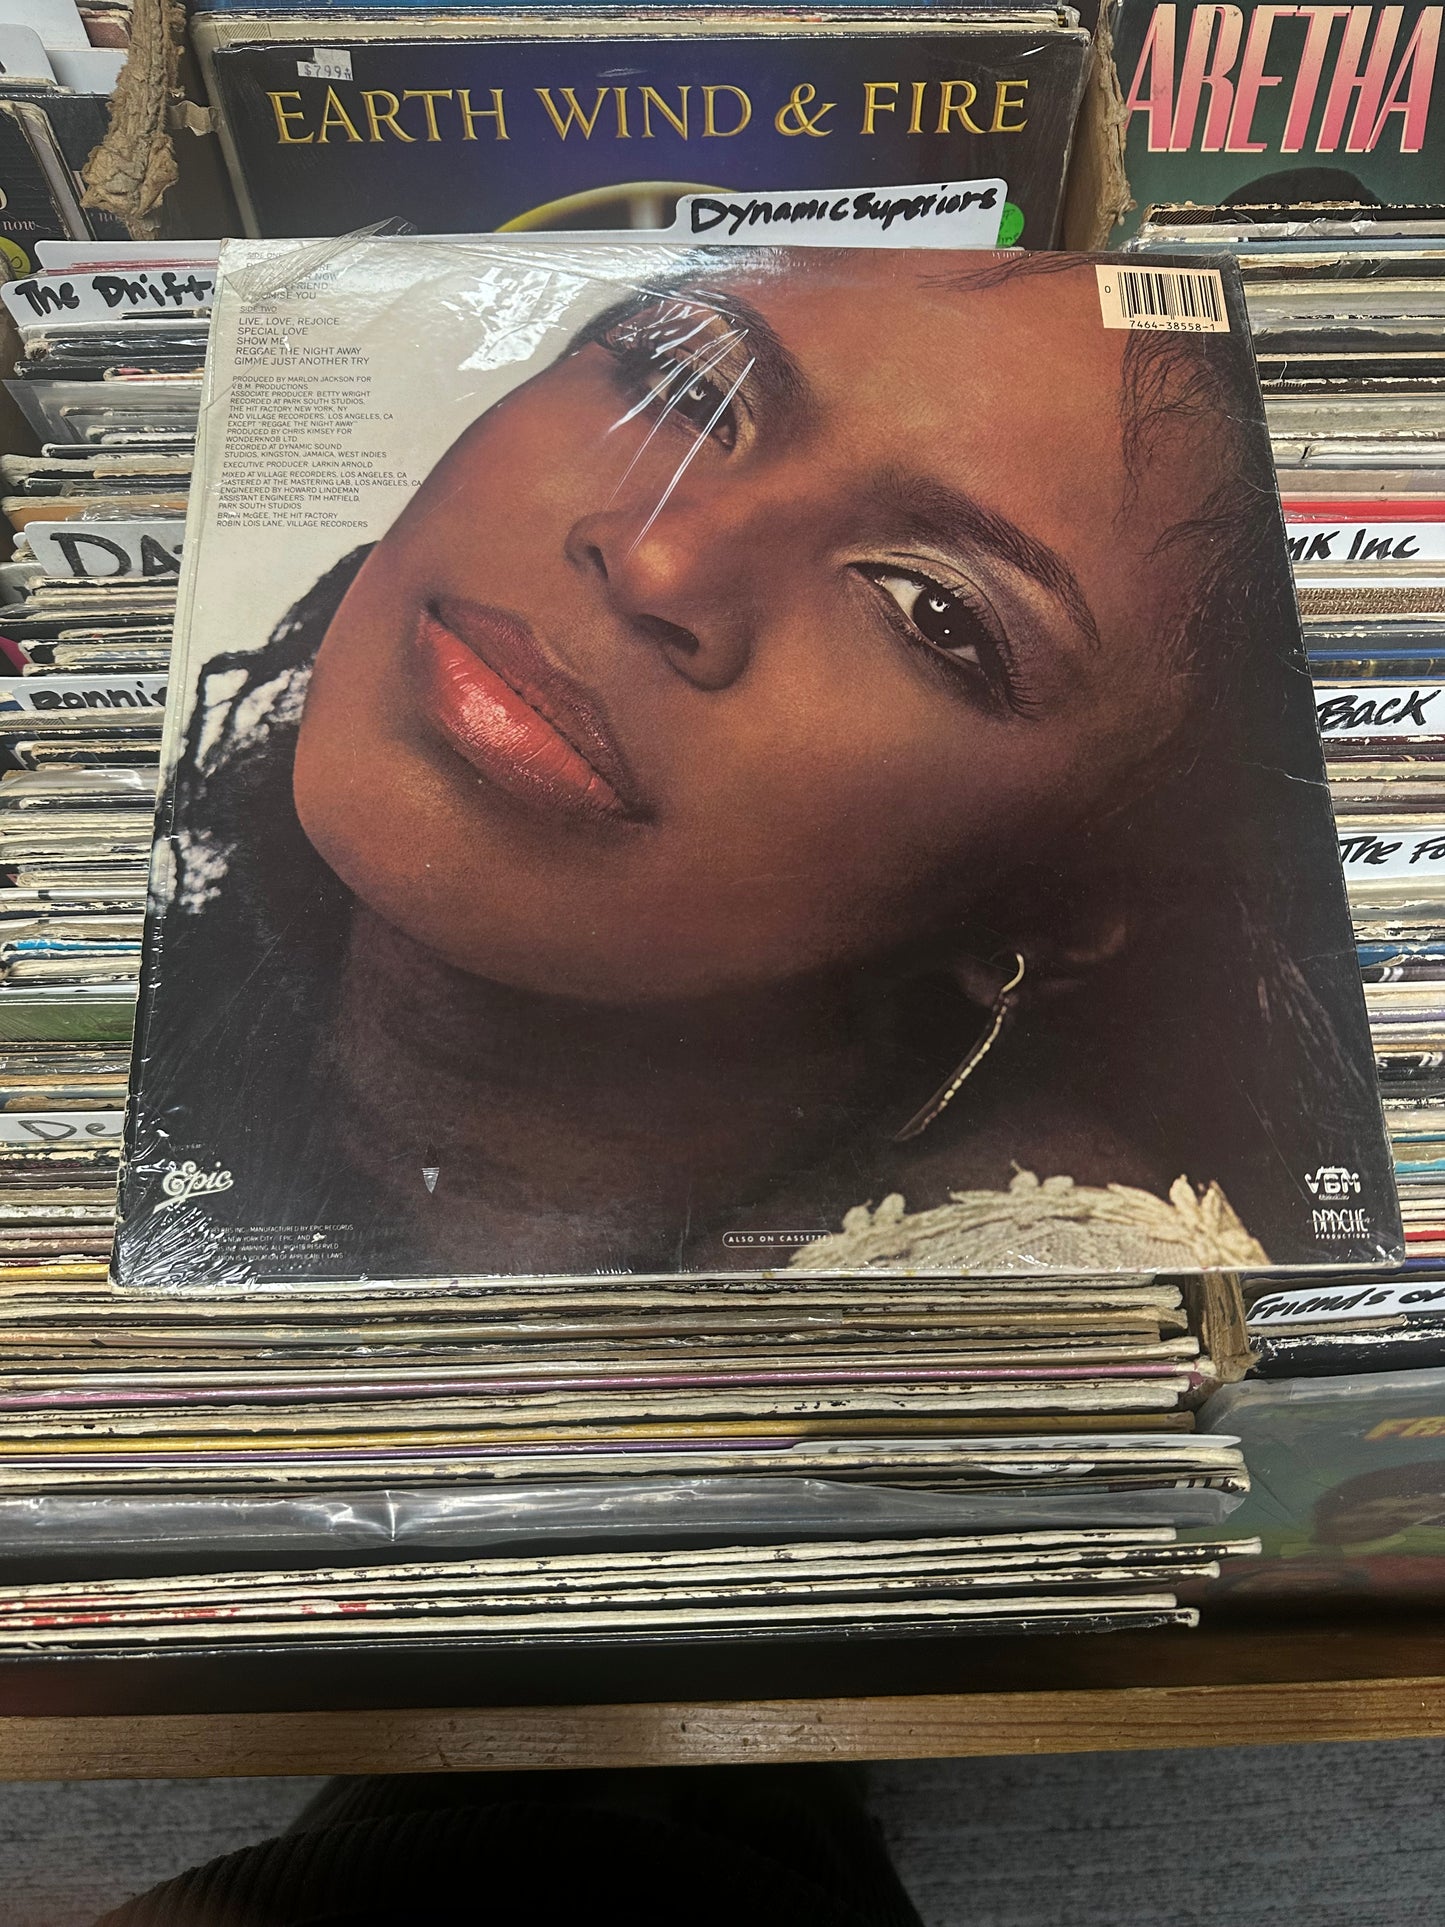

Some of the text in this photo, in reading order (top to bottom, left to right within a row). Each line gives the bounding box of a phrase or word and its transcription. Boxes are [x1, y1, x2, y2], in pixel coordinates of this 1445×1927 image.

[1126, 3, 1443, 152] ARETHA
[265, 79, 1030, 144] EARTH WIND & FIRE
[15, 272, 214, 317] The Drift
[296, 291, 317, 299] YOU
[241, 306, 278, 314] SIDE TWO
[298, 317, 341, 325] REJOICE
[1129, 319, 1216, 332] 7464-38558-1
[237, 327, 309, 335] SPECIAL LOVE
[236, 337, 285, 345] SHOW ME
[235, 347, 362, 355] REGGAE THE NIGHT AWAY
[234, 357, 370, 365] GIMME JUST ANOTHER TRY
[220, 486, 271, 494] ENGINEERED
[218, 502, 239, 510] PARK
[239, 502, 267, 510] SOUTH
[319, 520, 369, 528] RECORDERS
[1339, 836, 1403, 865] The
[153, 1160, 234, 1214] Epic
[728, 1236, 755, 1244] ALSO
[759, 1235, 775, 1243] ON
[1246, 1288, 1395, 1321] Friends
